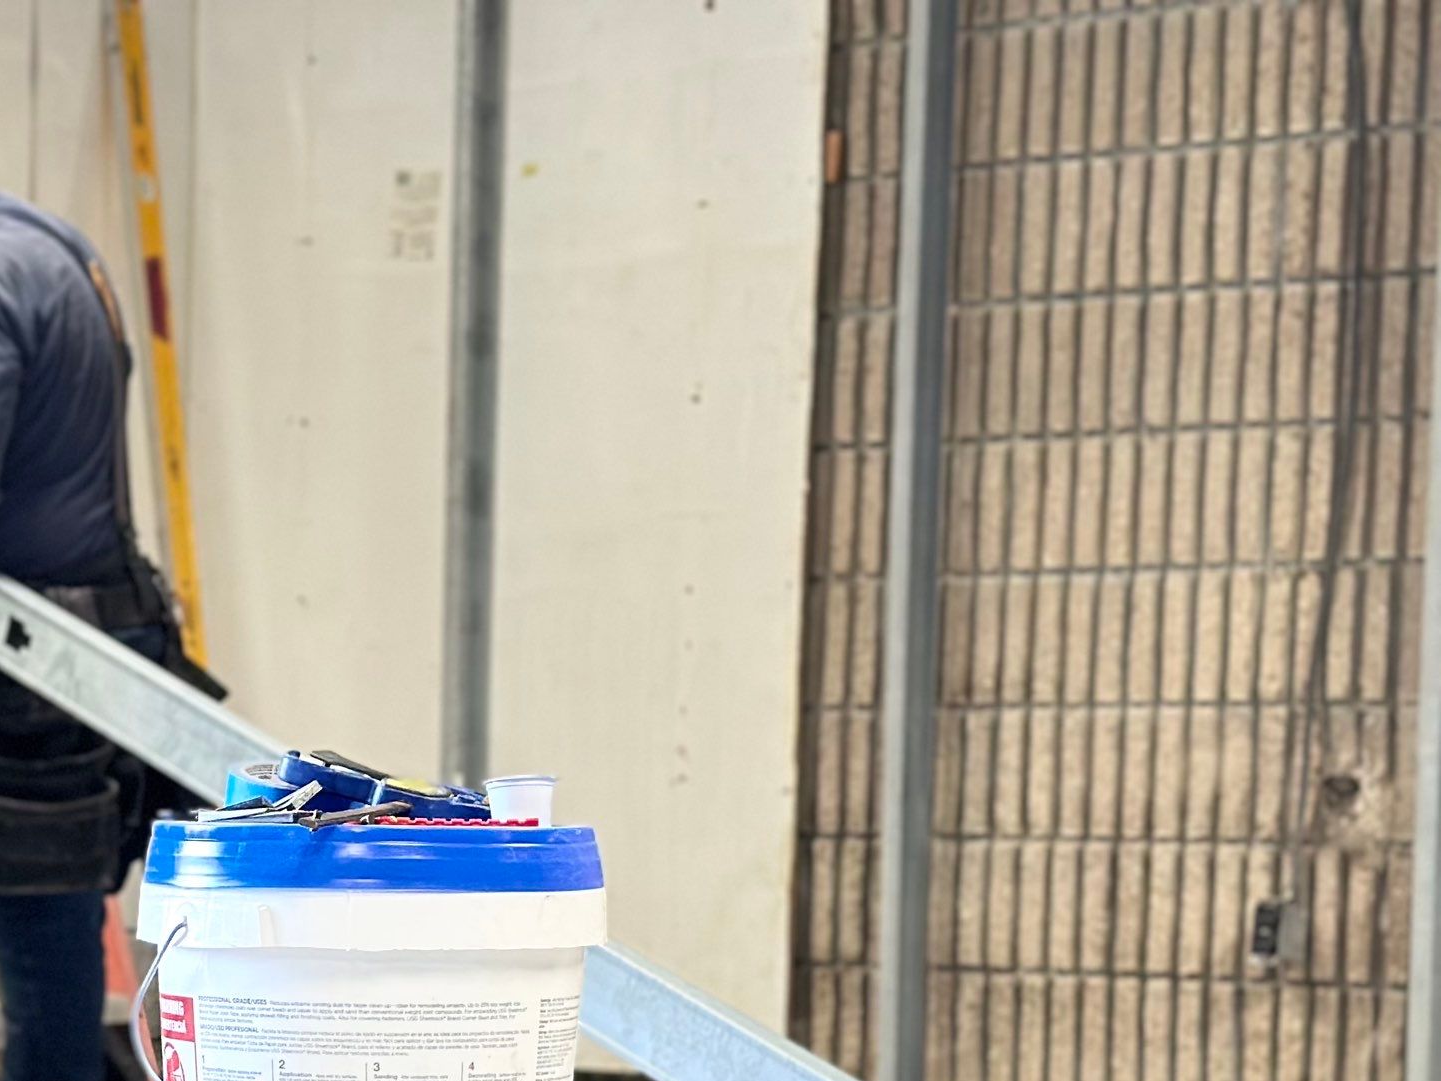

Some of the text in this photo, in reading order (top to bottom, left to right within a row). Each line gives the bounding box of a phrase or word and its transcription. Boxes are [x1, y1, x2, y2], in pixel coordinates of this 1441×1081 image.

[232, 997, 268, 1005] GRADE/USES
[225, 1025, 259, 1033] PROFESIONAL
[278, 1059, 286, 1070] 2
[373, 1062, 381, 1072] 3
[468, 1061, 475, 1071] 4
[279, 1071, 313, 1079] Application
